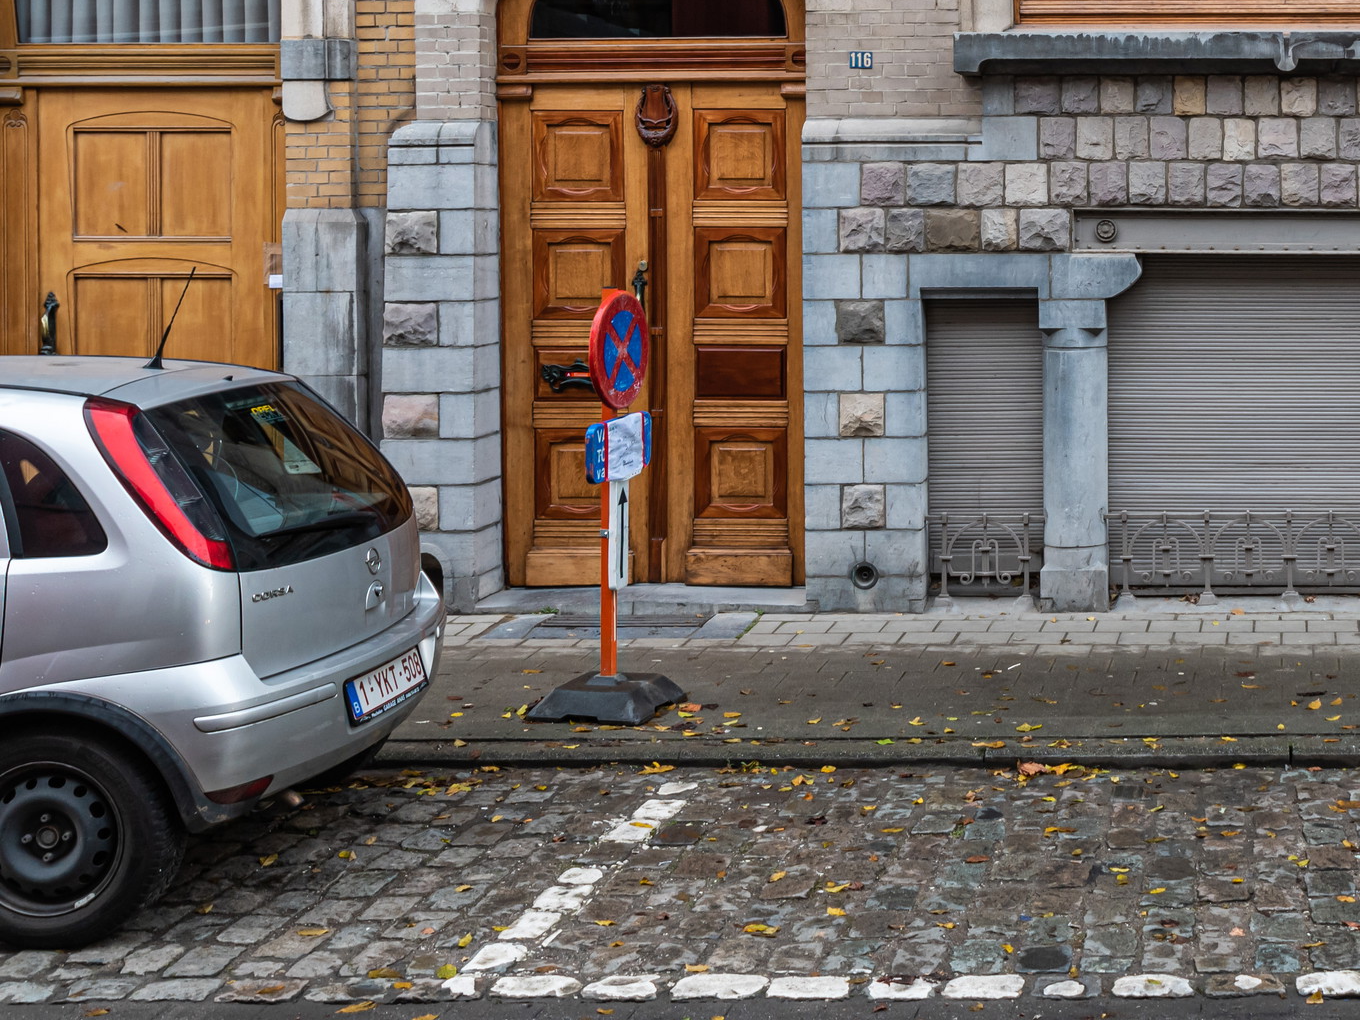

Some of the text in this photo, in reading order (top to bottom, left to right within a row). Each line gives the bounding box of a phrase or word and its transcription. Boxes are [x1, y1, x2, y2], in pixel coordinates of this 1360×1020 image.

[850, 52, 872, 67] 116
[251, 584, 294, 603] CORSA
[360, 652, 422, 706] 1-YKT-508
[353, 701, 361, 714] B
